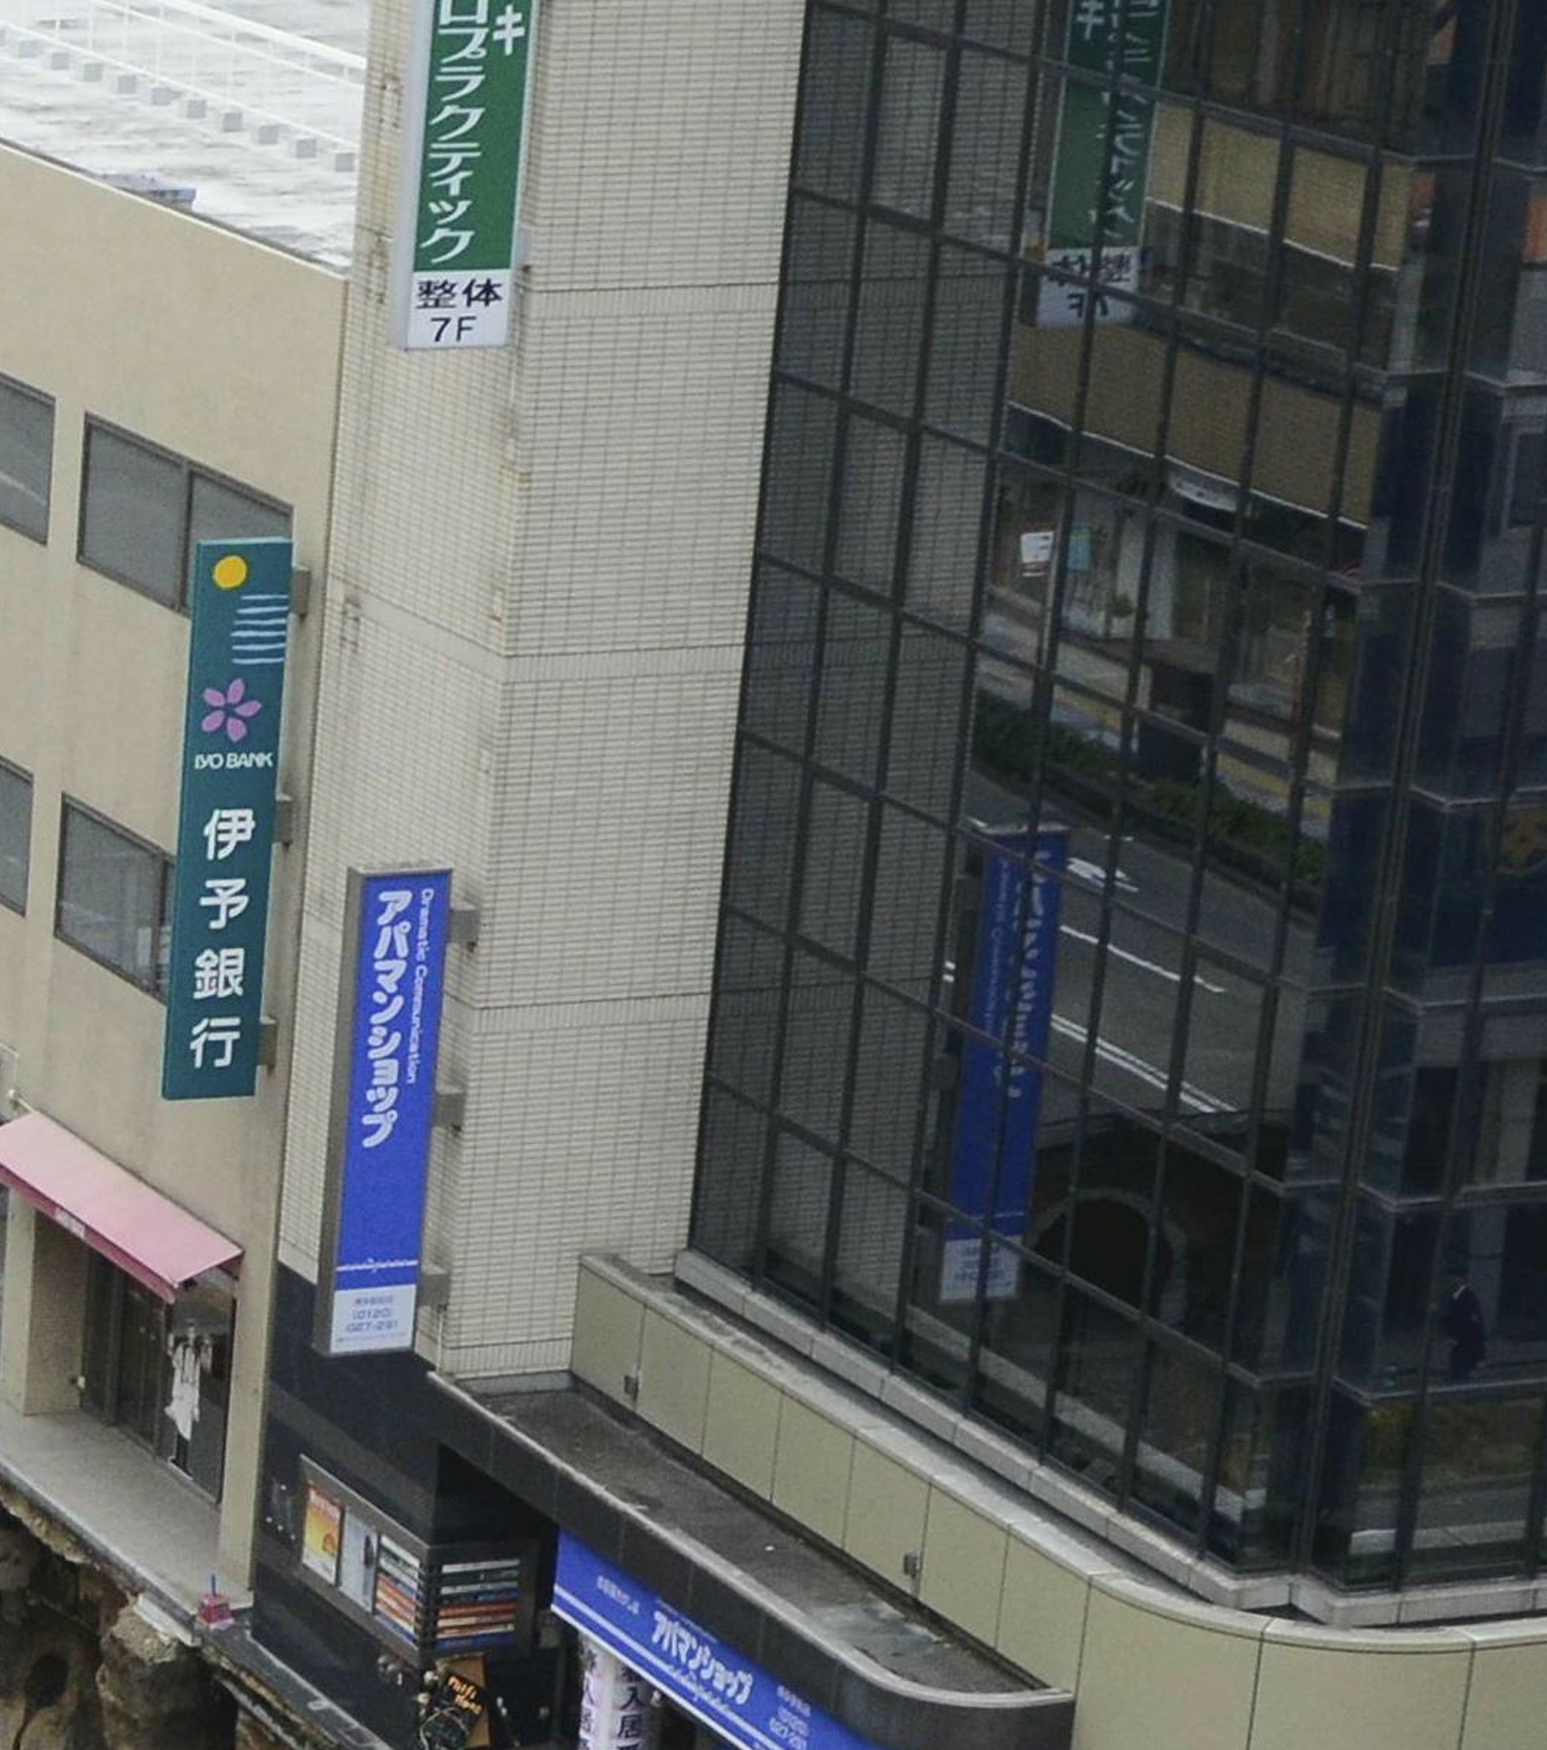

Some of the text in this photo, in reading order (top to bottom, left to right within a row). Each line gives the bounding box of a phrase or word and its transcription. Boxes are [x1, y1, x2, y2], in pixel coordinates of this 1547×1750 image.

[418, 0, 486, 265] ロプラクティック
[415, 278, 503, 309] 整体
[430, 316, 477, 344] 7F
[194, 752, 274, 769] IYO BANK
[190, 808, 256, 1071] 伊予銀行
[405, 887, 435, 1086] Dramatic Communication
[361, 889, 413, 1150] アパマンショップ
[651, 1609, 754, 1706] アパマンショップ
